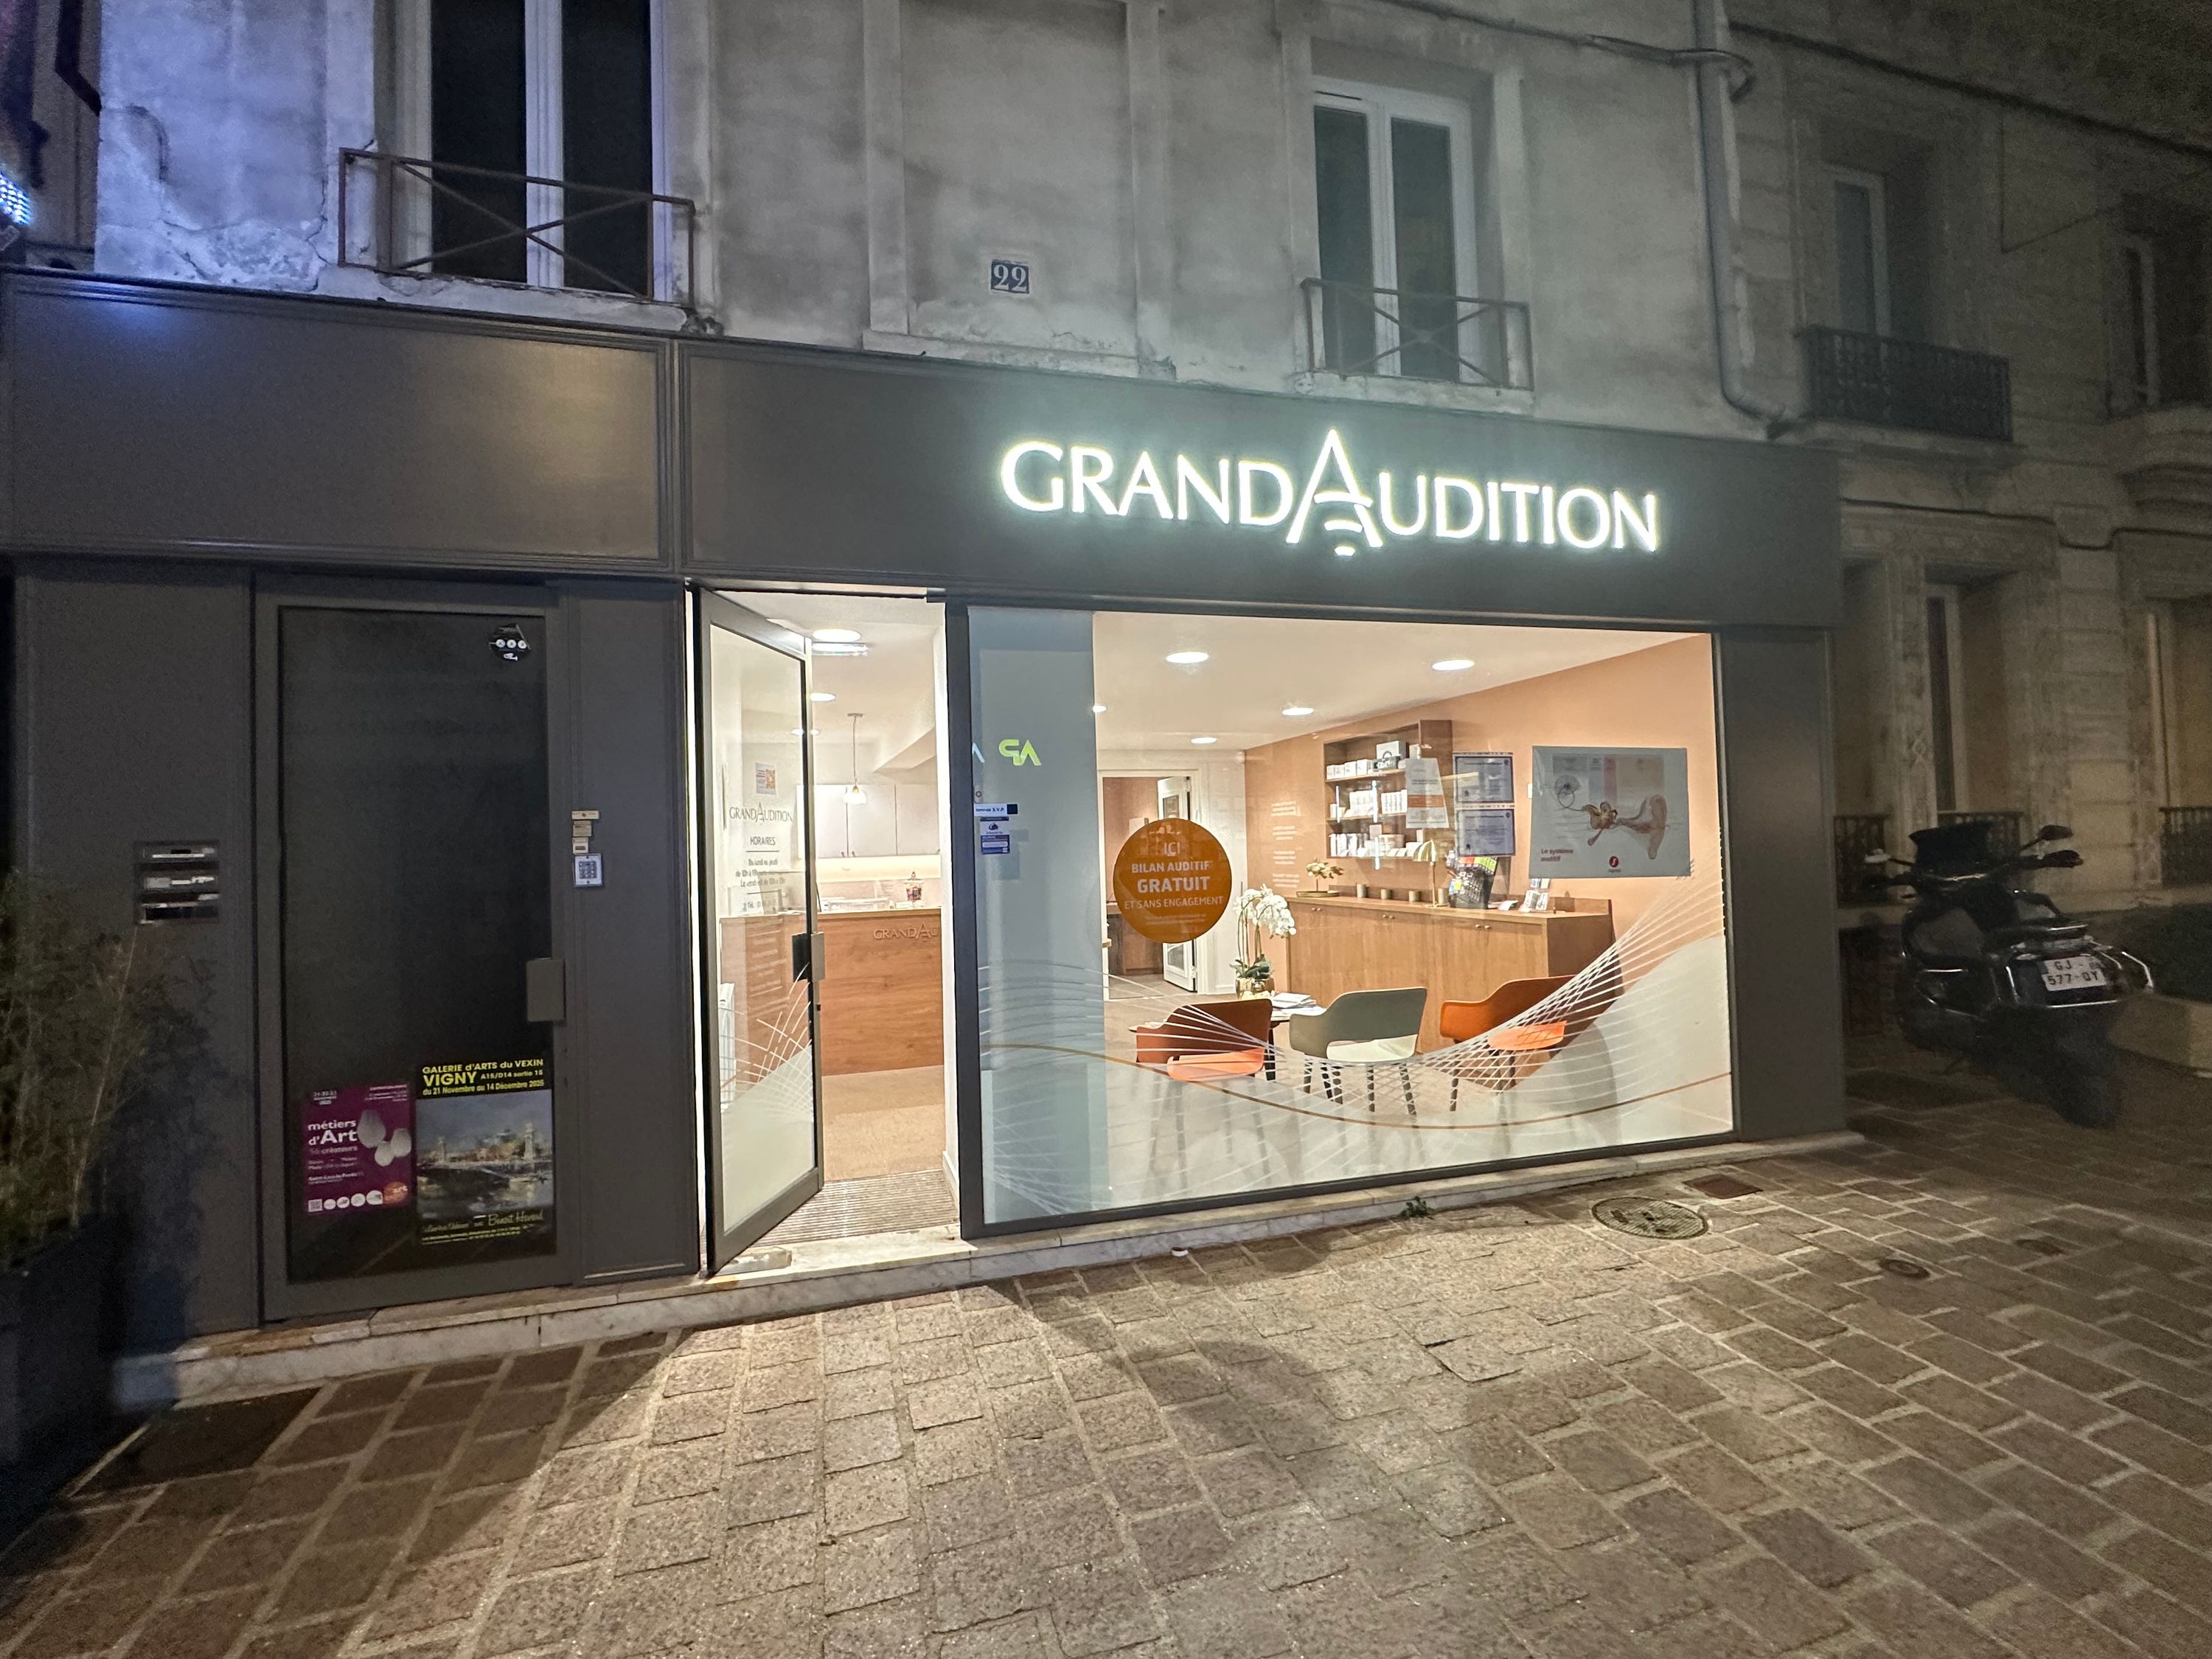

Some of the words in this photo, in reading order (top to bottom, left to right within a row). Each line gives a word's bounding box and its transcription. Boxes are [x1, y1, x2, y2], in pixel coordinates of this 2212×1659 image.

[993, 264, 1027, 293] 22
[1001, 428, 1658, 557] GRANDAUDITION
[750, 835, 776, 846] HORAIRES
[1131, 862, 1164, 874] BILAN
[1137, 876, 1210, 894] GRATUIT
[1124, 900, 1135, 910] ET
[1136, 898, 1161, 909] SANS
[1164, 895, 1225, 908] ENGAGEMENT
[422, 1064, 462, 1074] GALERIE
[465, 1062, 498, 1071] d'ARTS
[500, 1061, 513, 1069] du
[515, 1059, 544, 1068] VEXIN
[422, 1071, 477, 1087] VIGNY
[481, 1071, 512, 1080] A15/D14
[422, 1088, 431, 1096] du
[433, 1087, 441, 1095] 21
[442, 1085, 476, 1094] Novembre
[495, 1081, 528, 1091] Décembre
[307, 1119, 357, 1131] métiers
[308, 1129, 358, 1146] d'Art
